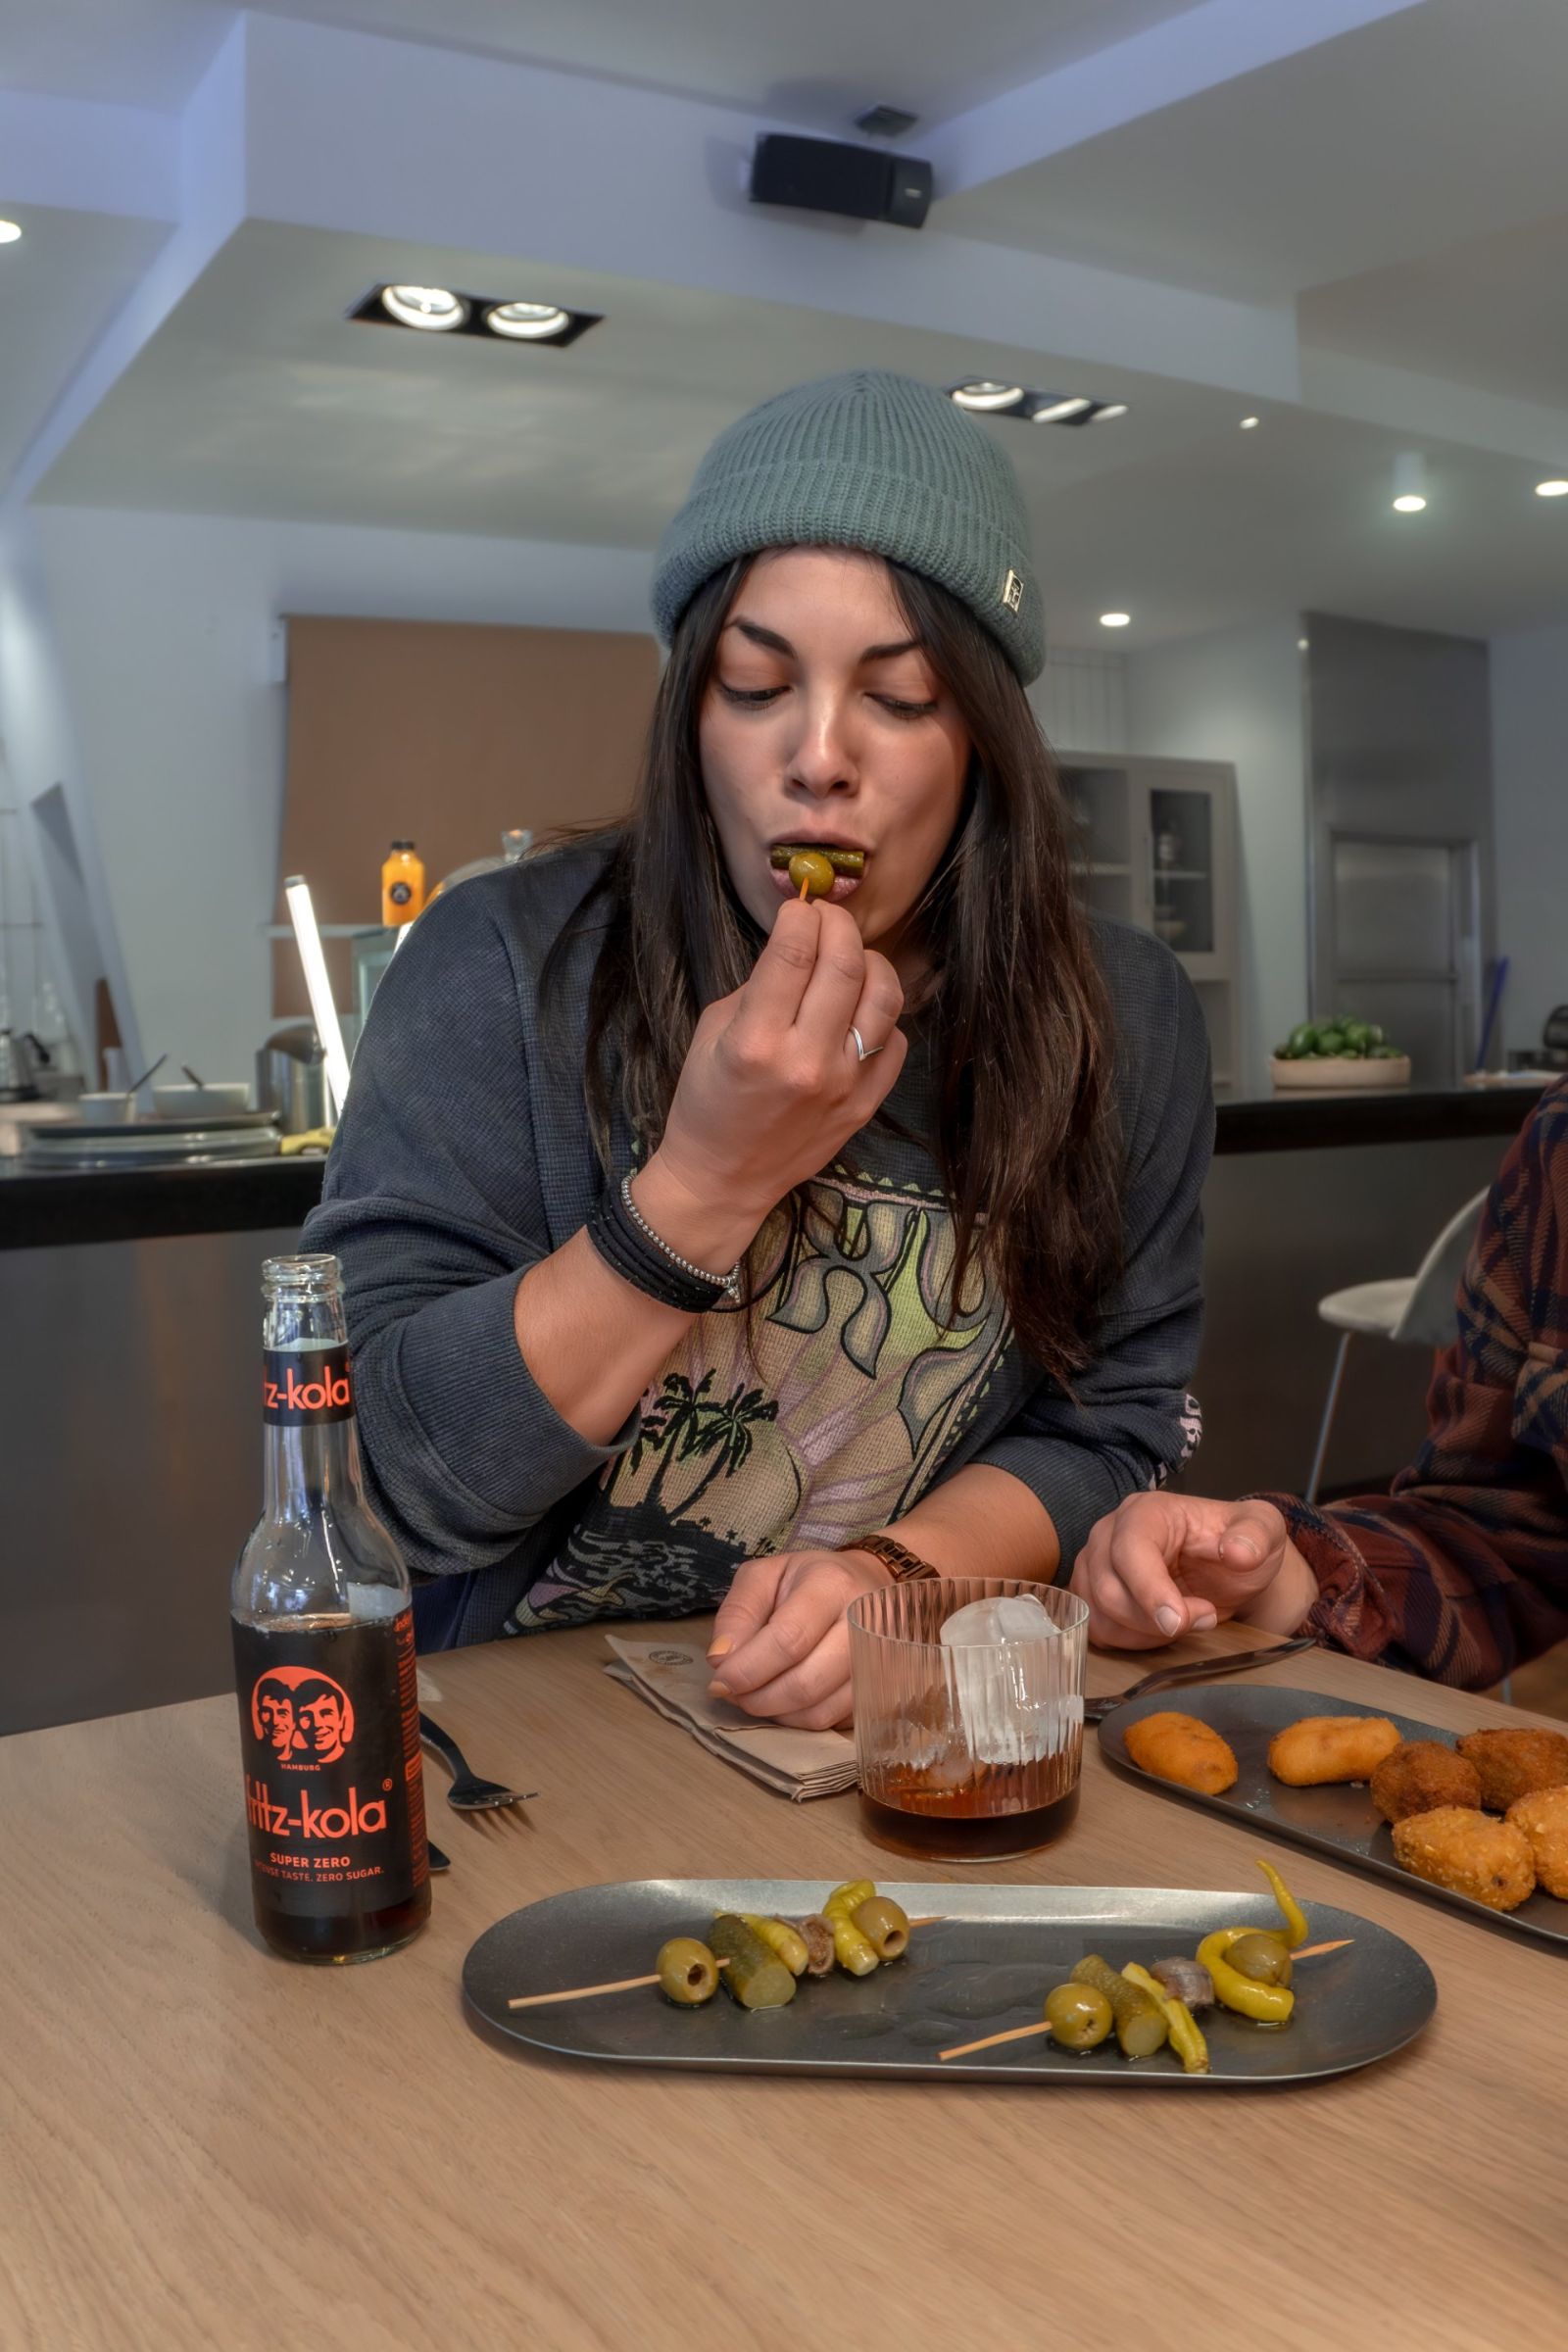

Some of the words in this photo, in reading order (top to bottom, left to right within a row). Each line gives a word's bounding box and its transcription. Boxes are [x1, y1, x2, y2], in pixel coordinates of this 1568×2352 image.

[280, 1763, 321, 1772] HAMBURG
[270, 1851, 310, 1868] SUPER
[314, 1856, 351, 1869] ZERO
[316, 1873, 344, 1883] ZERO
[346, 1866, 385, 1881] SUGAR.
